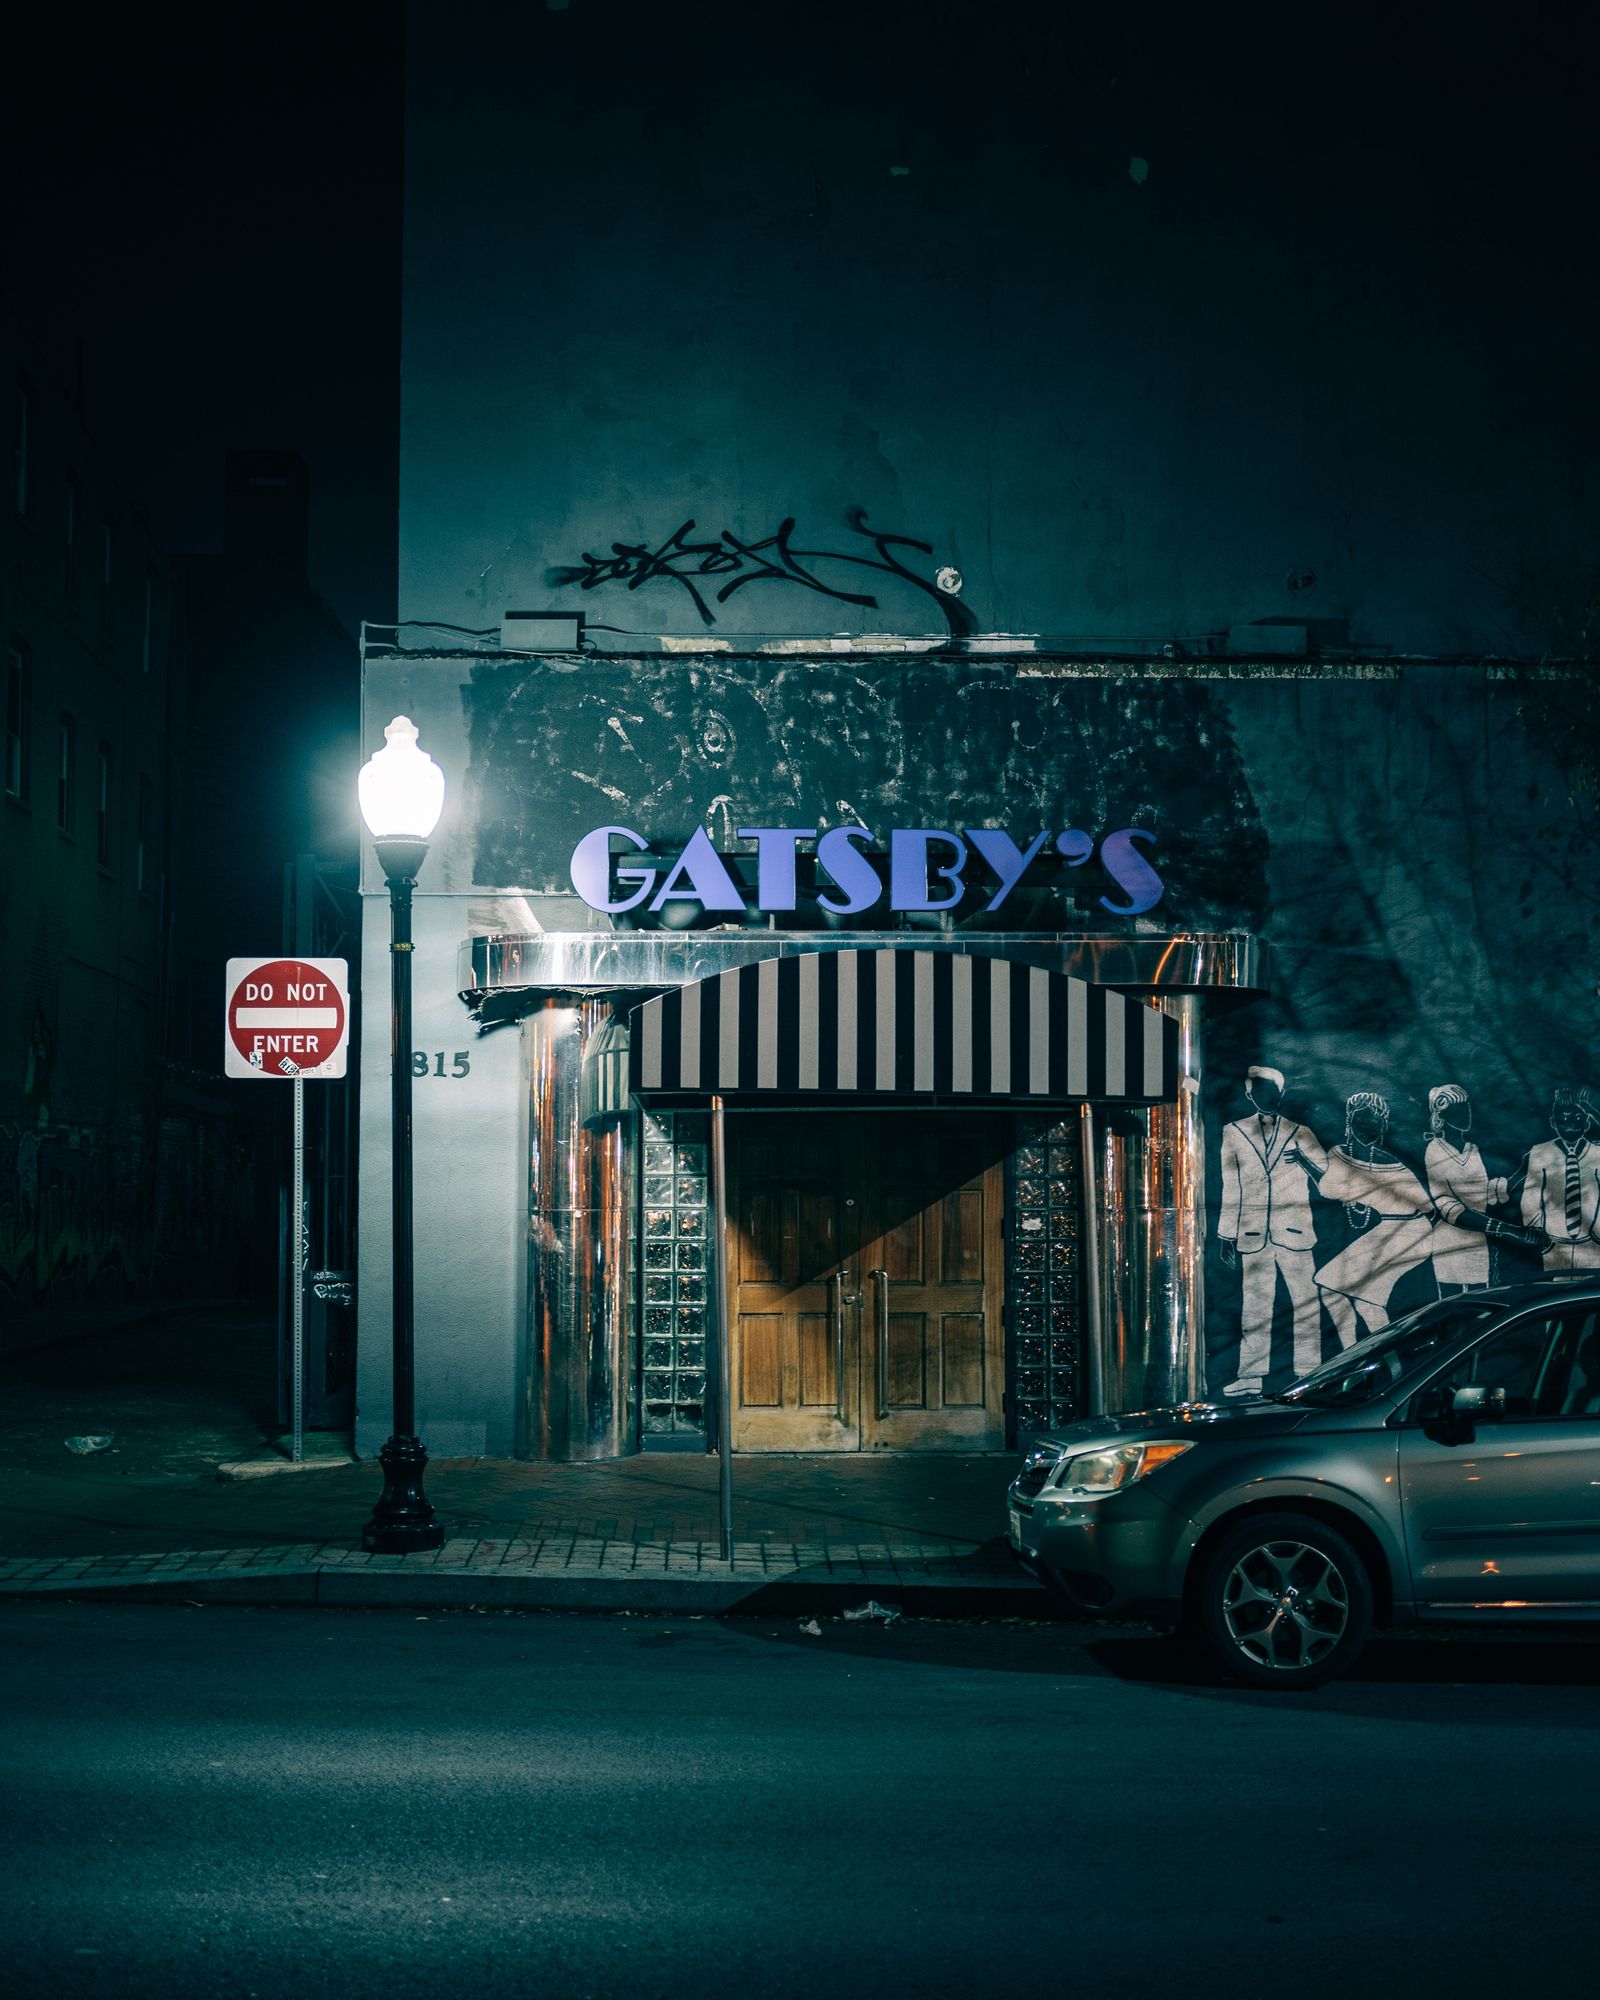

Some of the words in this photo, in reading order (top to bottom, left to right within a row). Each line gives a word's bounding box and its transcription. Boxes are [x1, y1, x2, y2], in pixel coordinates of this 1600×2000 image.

[570, 824, 1165, 916] GATSBY'S
[245, 983, 274, 1002] DO
[286, 983, 328, 1002] NOT
[253, 1035, 319, 1053] ENTER
[390, 1051, 470, 1078] 815
